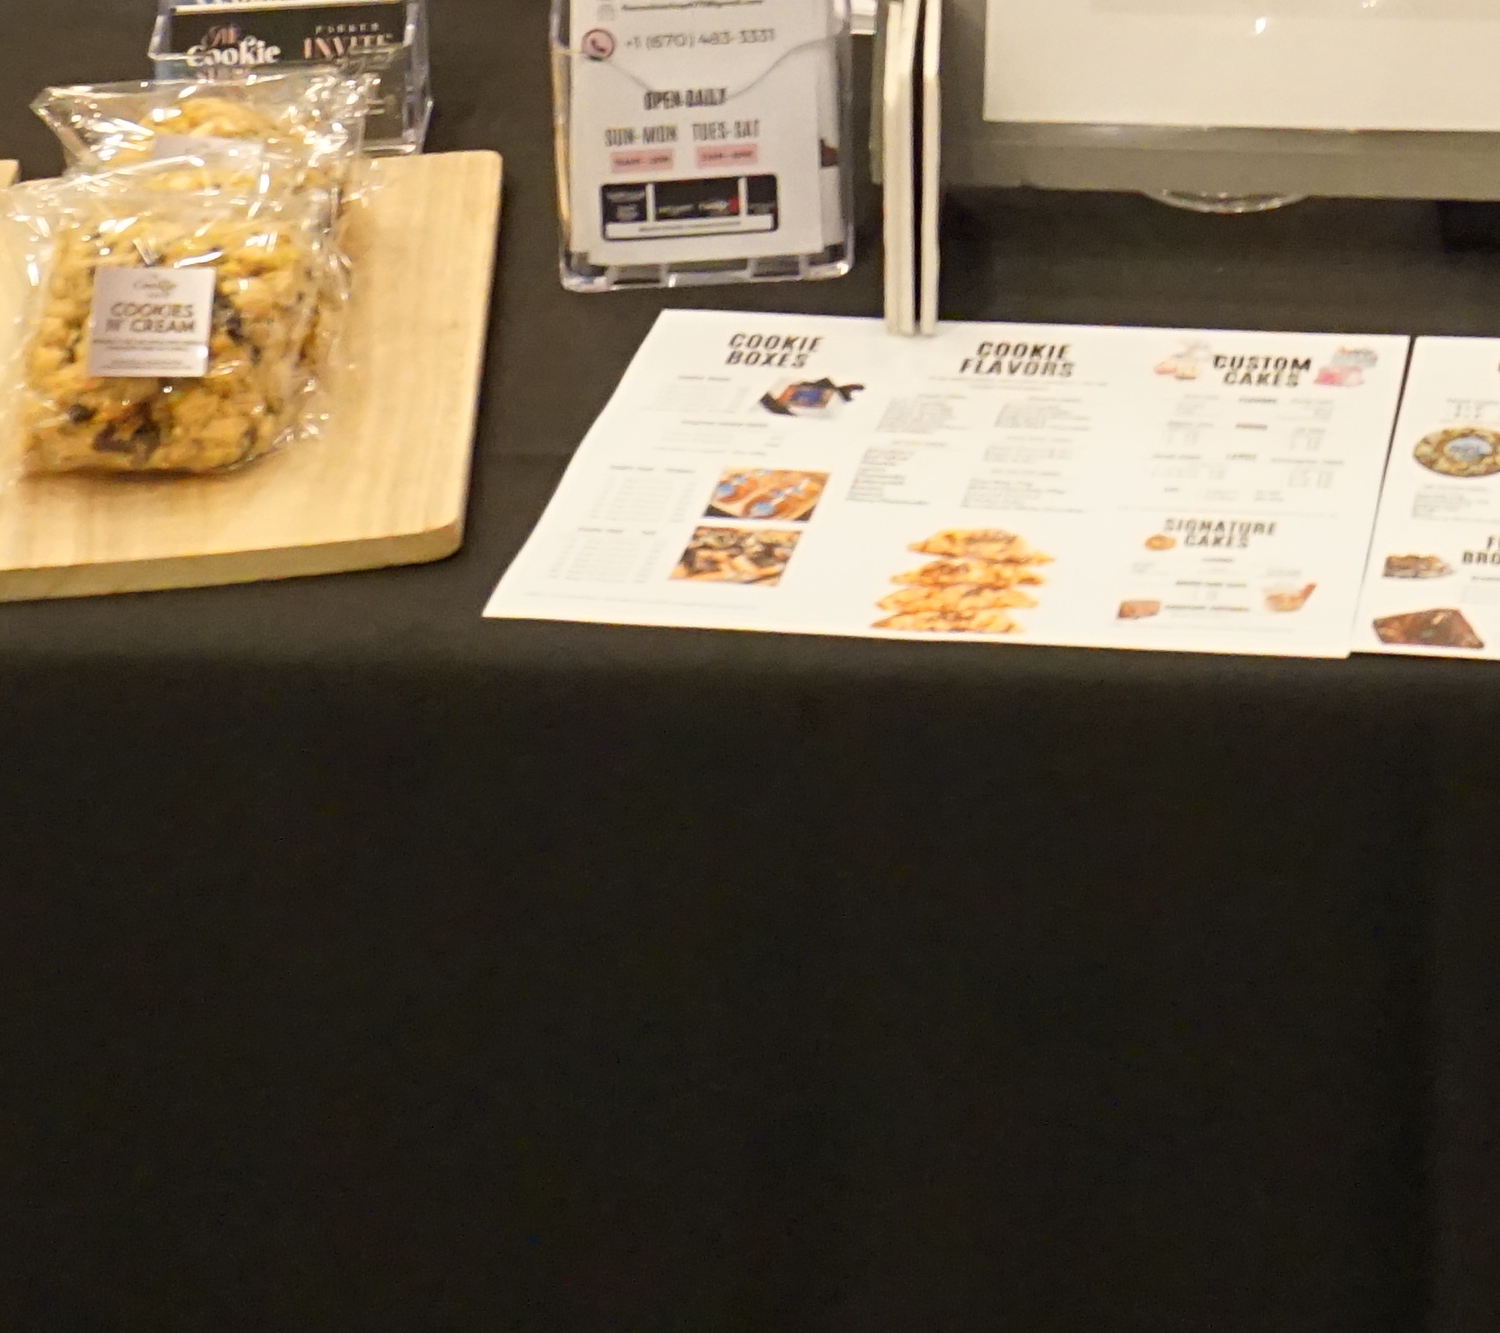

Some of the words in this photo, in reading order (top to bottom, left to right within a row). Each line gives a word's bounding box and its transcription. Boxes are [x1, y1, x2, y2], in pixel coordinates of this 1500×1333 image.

[186, 35, 282, 68] Cookie
[110, 301, 195, 318] COOKIES
[130, 318, 195, 334] CREAM
[728, 332, 827, 353] COOKIE
[975, 340, 1074, 361] COOKIE
[724, 350, 810, 369] BOXES
[958, 357, 1078, 379] FLAVORS
[1214, 353, 1314, 372] CUSTOM
[1222, 369, 1301, 388] CAKES
[1163, 518, 1279, 537] SIGNATURE
[1183, 532, 1250, 550] CAKES
